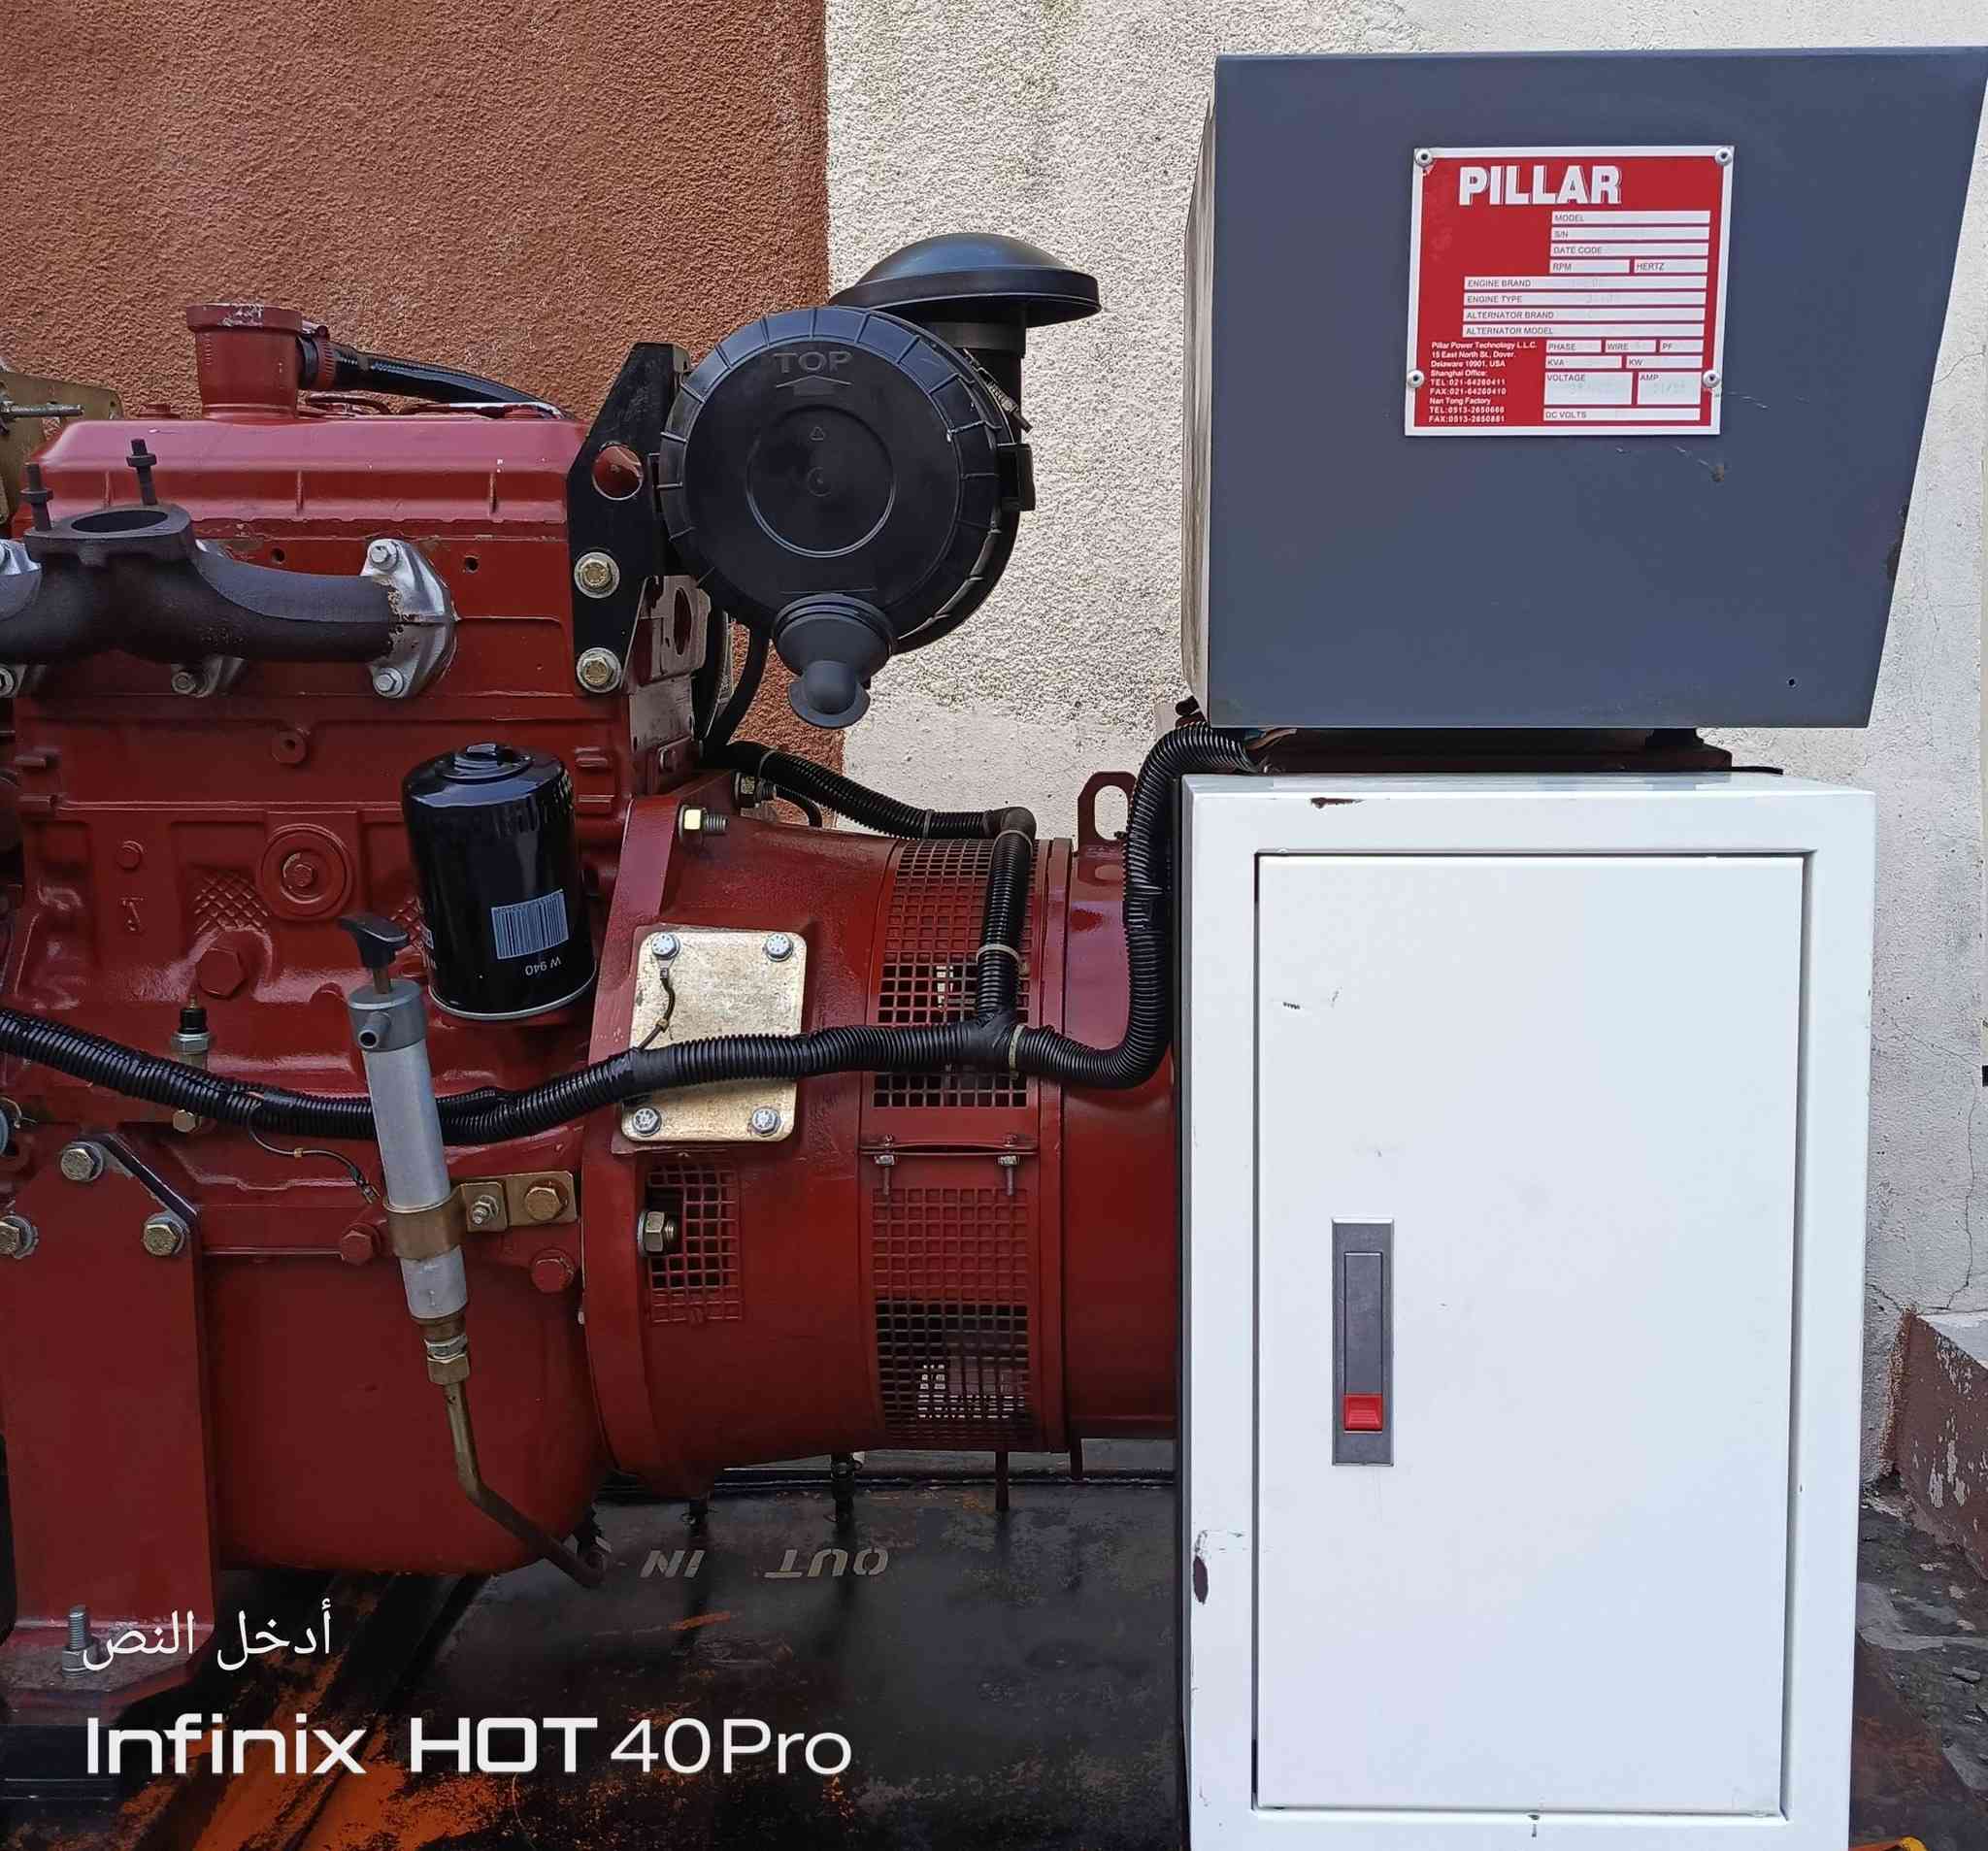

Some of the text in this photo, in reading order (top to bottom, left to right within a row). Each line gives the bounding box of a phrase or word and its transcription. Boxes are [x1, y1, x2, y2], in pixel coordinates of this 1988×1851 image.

[1459, 164, 1622, 206] PILLAR
[1554, 214, 1584, 222] MODEL
[1553, 230, 1569, 239] S/N
[1552, 263, 1572, 272] RPM
[1636, 262, 1665, 271] HERTZ
[1467, 279, 1531, 287] ENGINE BRAND
[1467, 294, 1522, 304] ENGINE TYPE
[1466, 311, 1554, 319] ALTERNATOR BRAND
[1524, 326, 1553, 335] MODEL
[1474, 342, 1515, 350] Technology
[1548, 342, 1576, 350] PHASE
[1607, 342, 1629, 350] WIRE
[774, 350, 852, 374] TOP
[1445, 397, 1464, 406] Tong
[1545, 411, 1587, 419] DC VOLTS
[525, 956, 562, 975] W 940
[640, 1550, 706, 1578] IN
[764, 1548, 889, 1578] OUT
